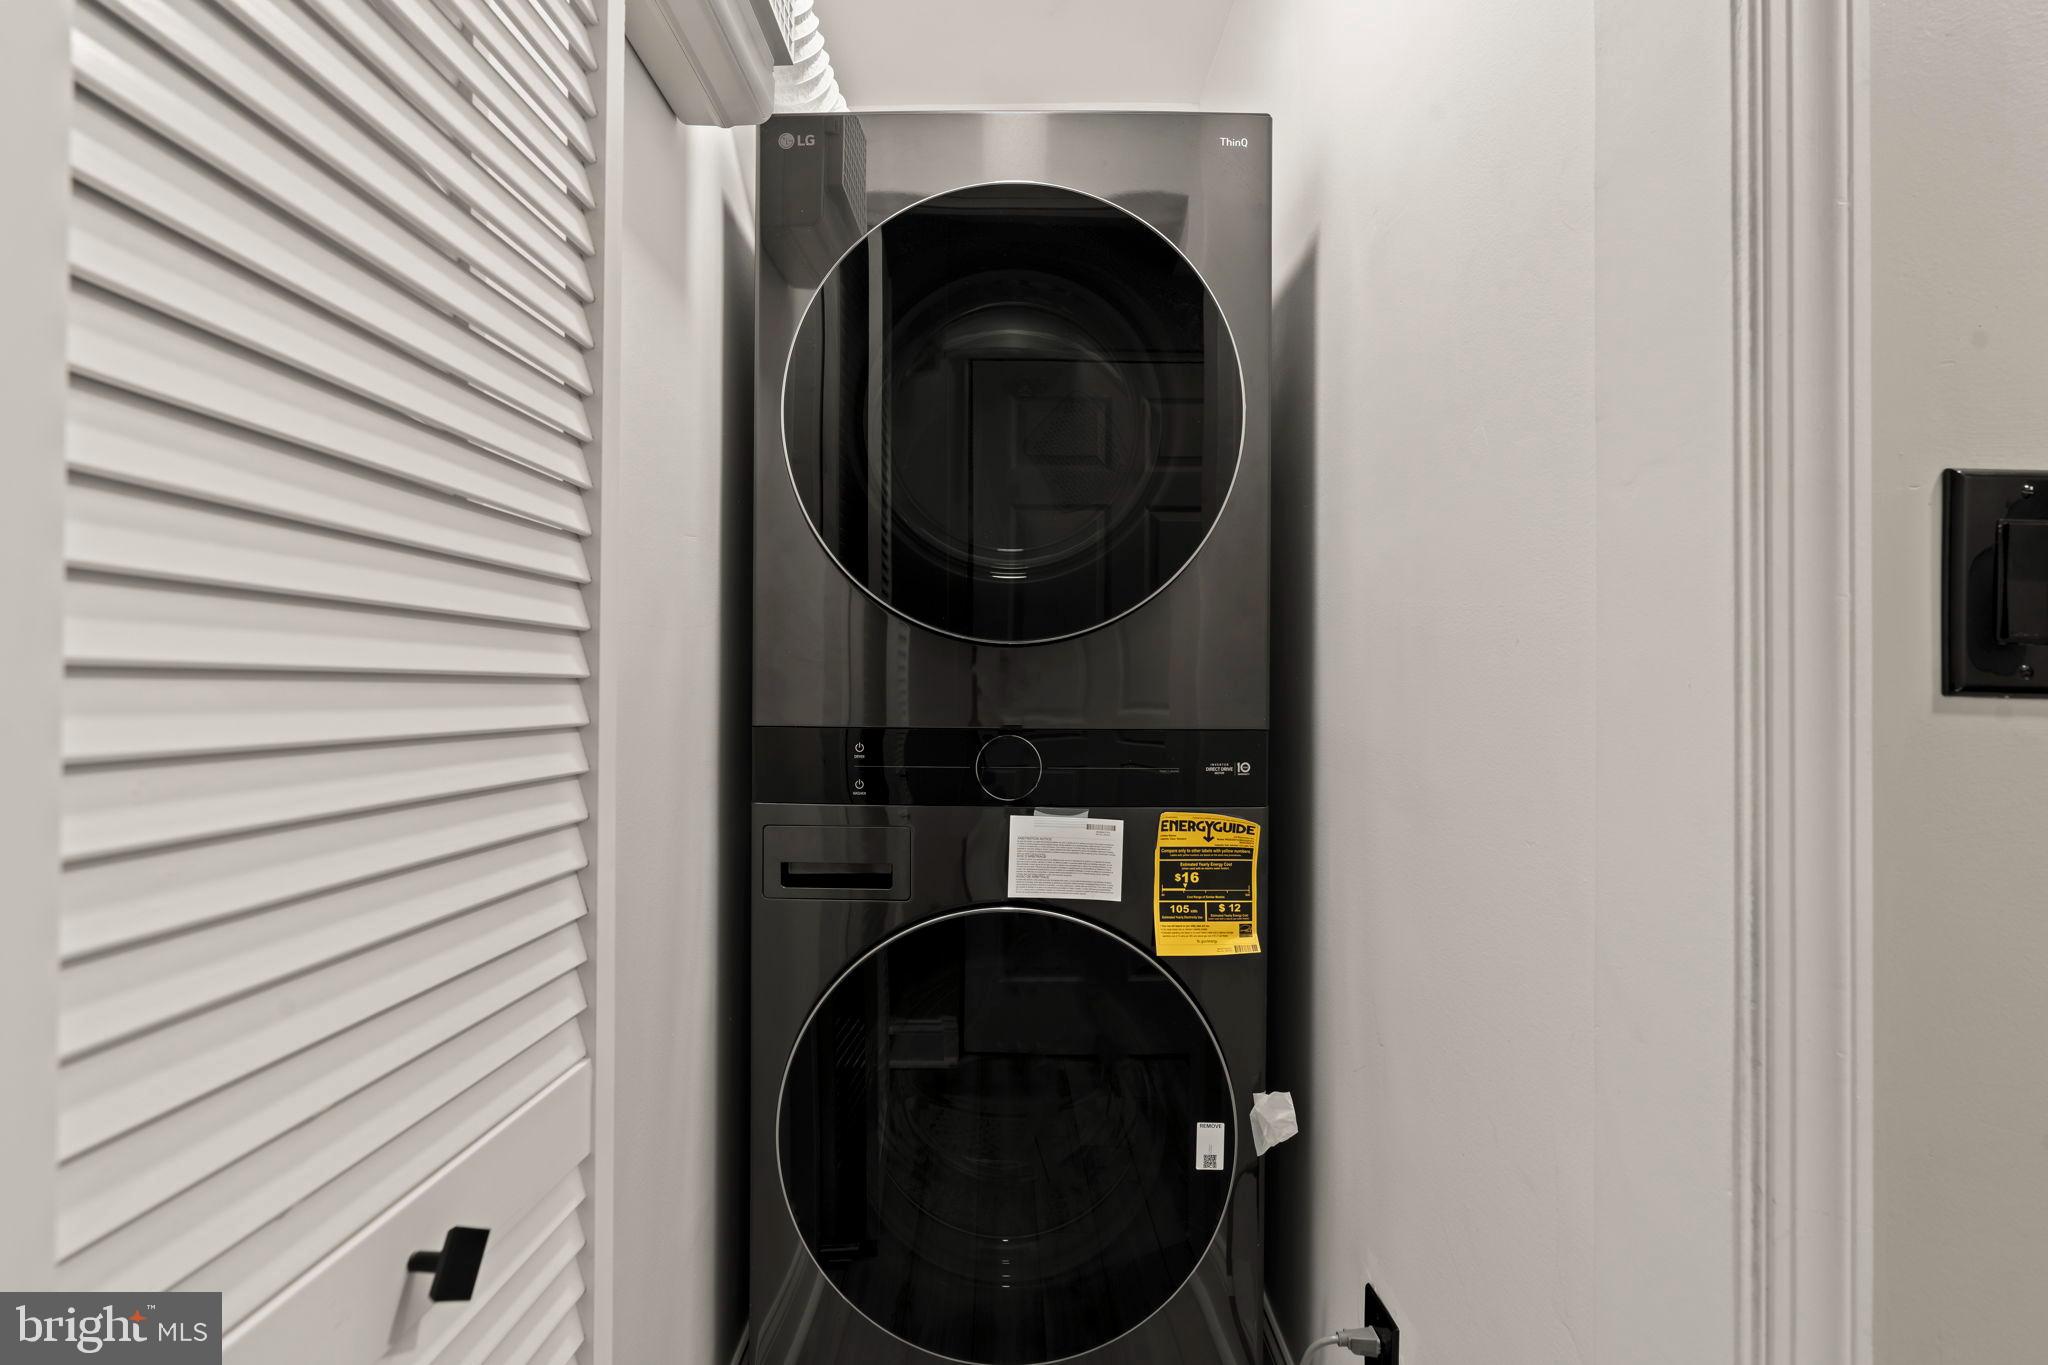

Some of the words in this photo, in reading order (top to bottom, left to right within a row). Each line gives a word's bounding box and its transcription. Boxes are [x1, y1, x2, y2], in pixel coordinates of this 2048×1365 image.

[797, 134, 816, 146] LG
[1220, 137, 1248, 147] ThinQ
[1160, 819, 1256, 836] ENERGYGUIDE
[1174, 871, 1200, 883] $16
[1170, 904, 1190, 913] 105
[1218, 903, 1226, 913] $
[1228, 903, 1241, 912] 12
